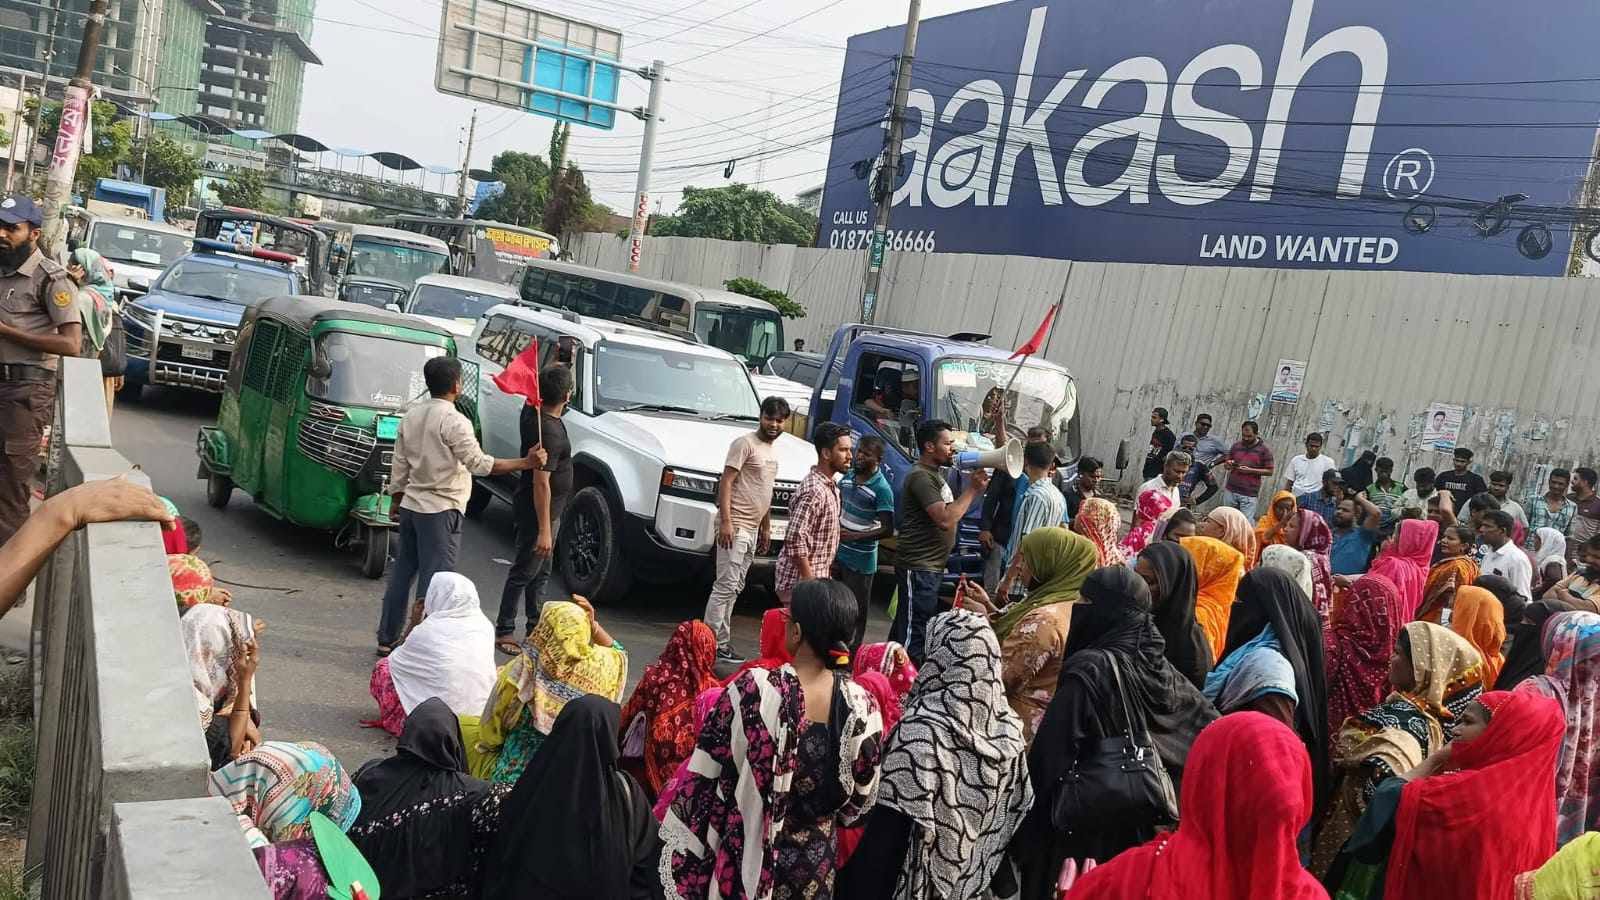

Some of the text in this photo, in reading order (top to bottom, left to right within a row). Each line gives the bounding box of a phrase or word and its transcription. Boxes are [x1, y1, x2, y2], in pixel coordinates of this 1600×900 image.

[868, 0, 1388, 207] aakash
[833, 210, 869, 225] CALL US
[830, 229, 936, 253] 0187936666
[1199, 233, 1400, 264] LAND WANTED
